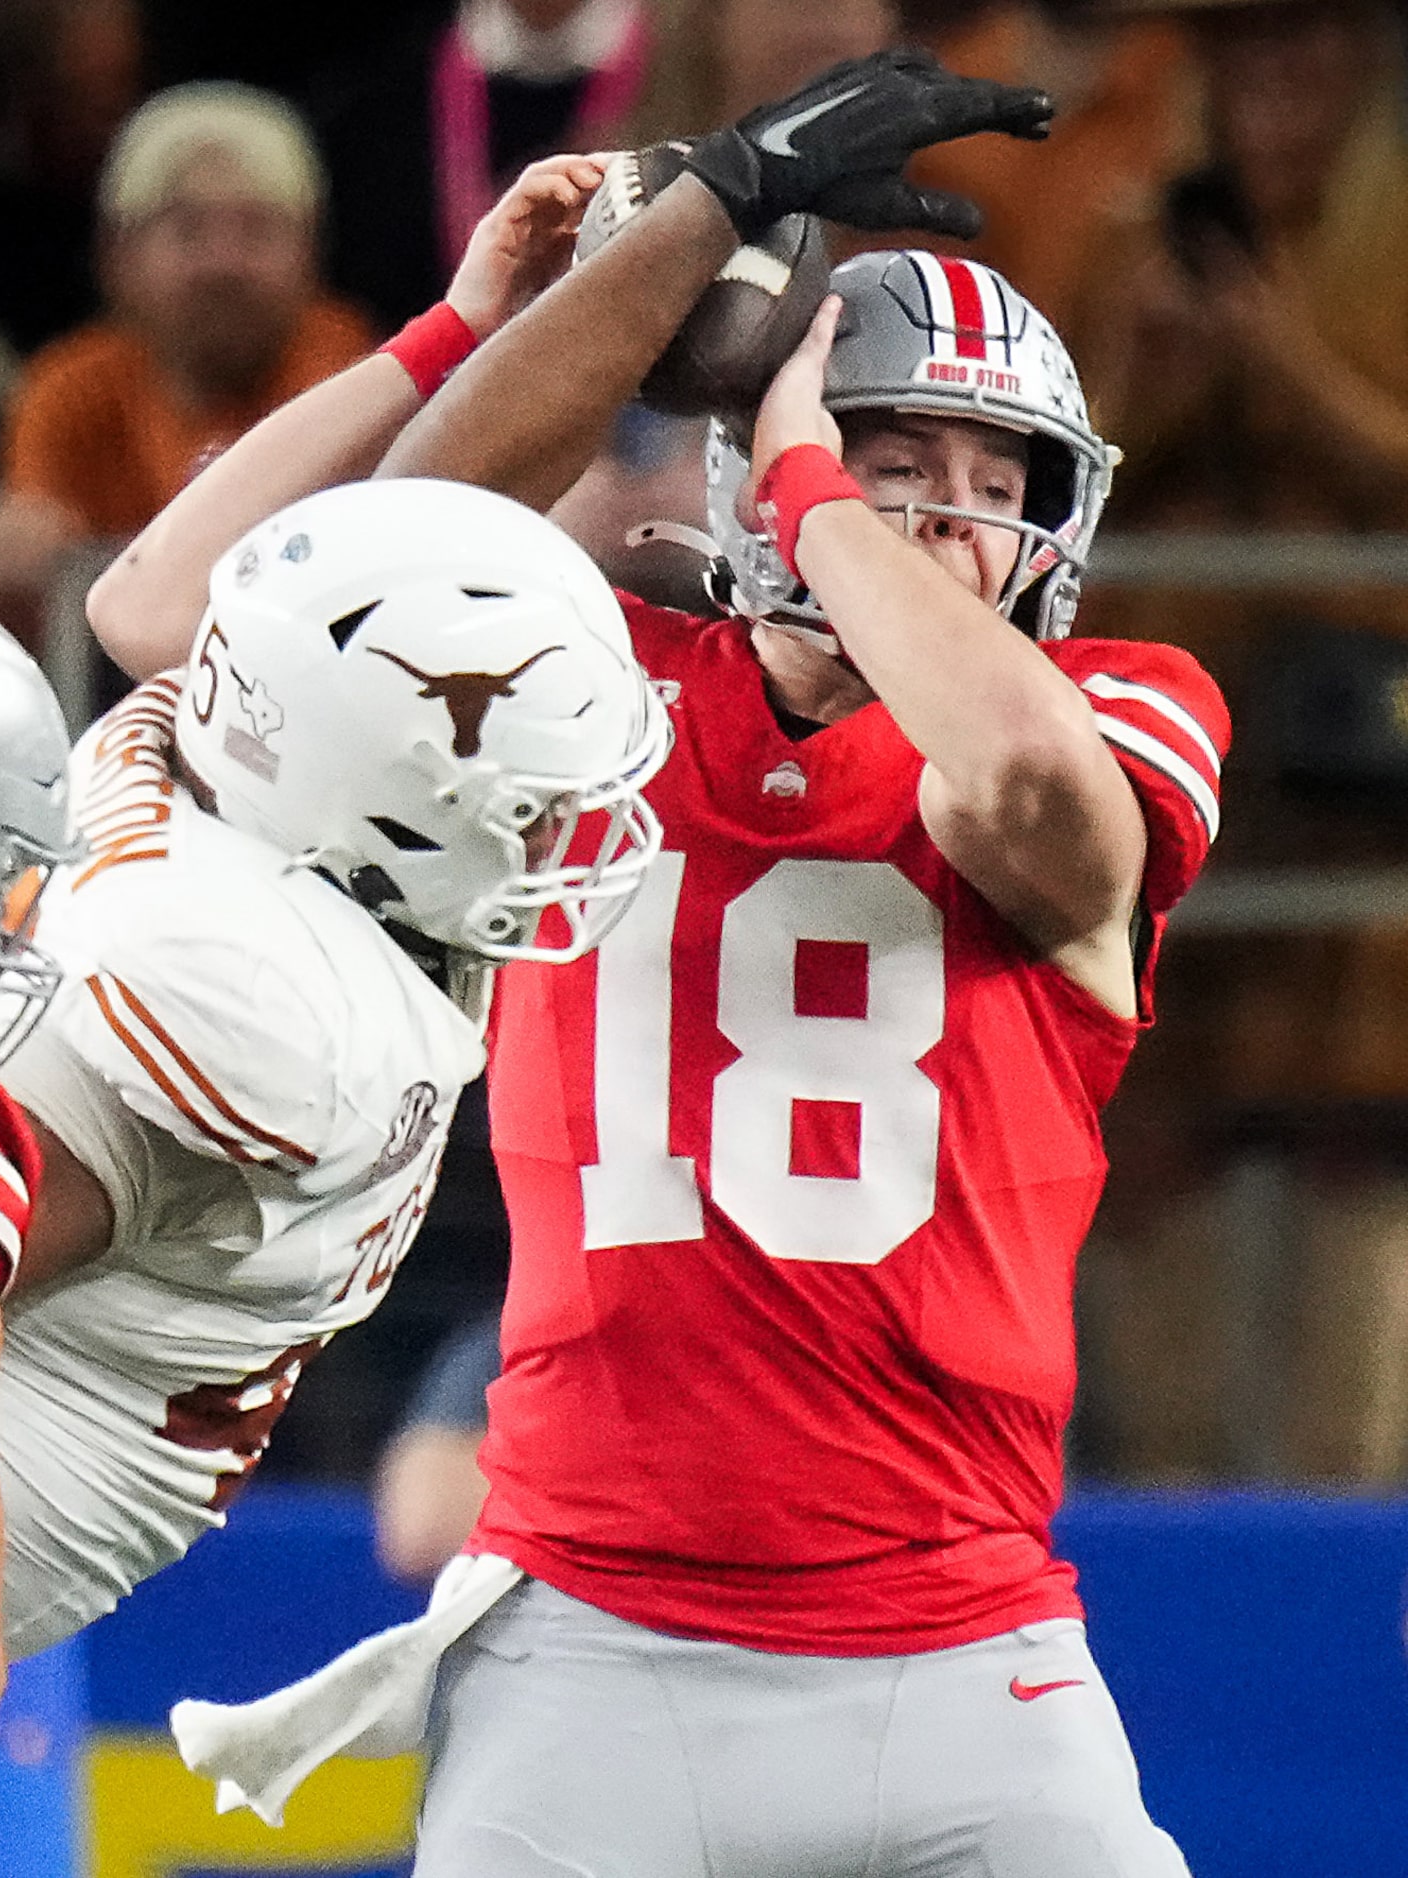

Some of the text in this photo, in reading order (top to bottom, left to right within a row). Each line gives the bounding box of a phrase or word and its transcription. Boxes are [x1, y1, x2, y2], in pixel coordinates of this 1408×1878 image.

[927, 362, 1022, 395] OHIO STATE
[580, 850, 947, 1265] 18
